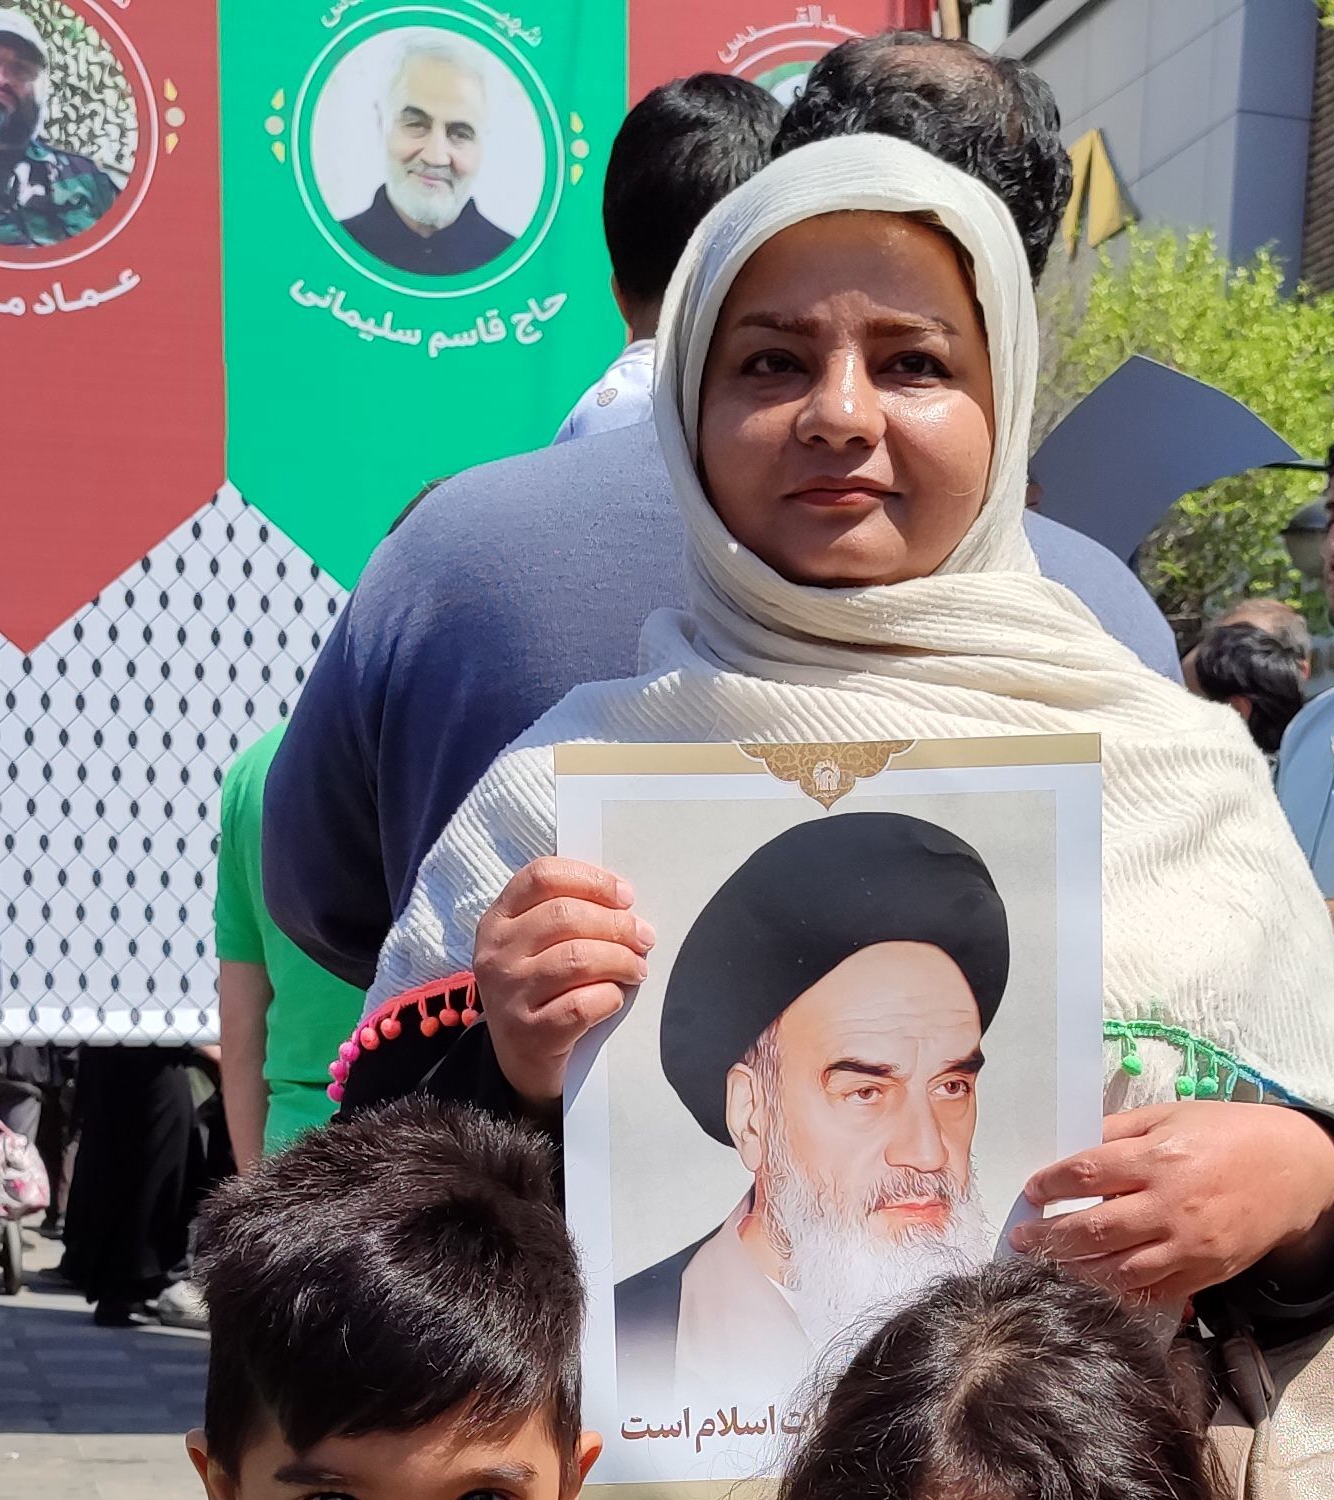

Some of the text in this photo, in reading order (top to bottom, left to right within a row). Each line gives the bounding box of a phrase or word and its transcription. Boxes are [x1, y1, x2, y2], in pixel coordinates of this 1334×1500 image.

[32, 268, 142, 316] عماد
[288, 278, 568, 359] حاج قاسم سلیمانی
[620, 1406, 690, 1441] است
[695, 1403, 775, 1454] اسلام
